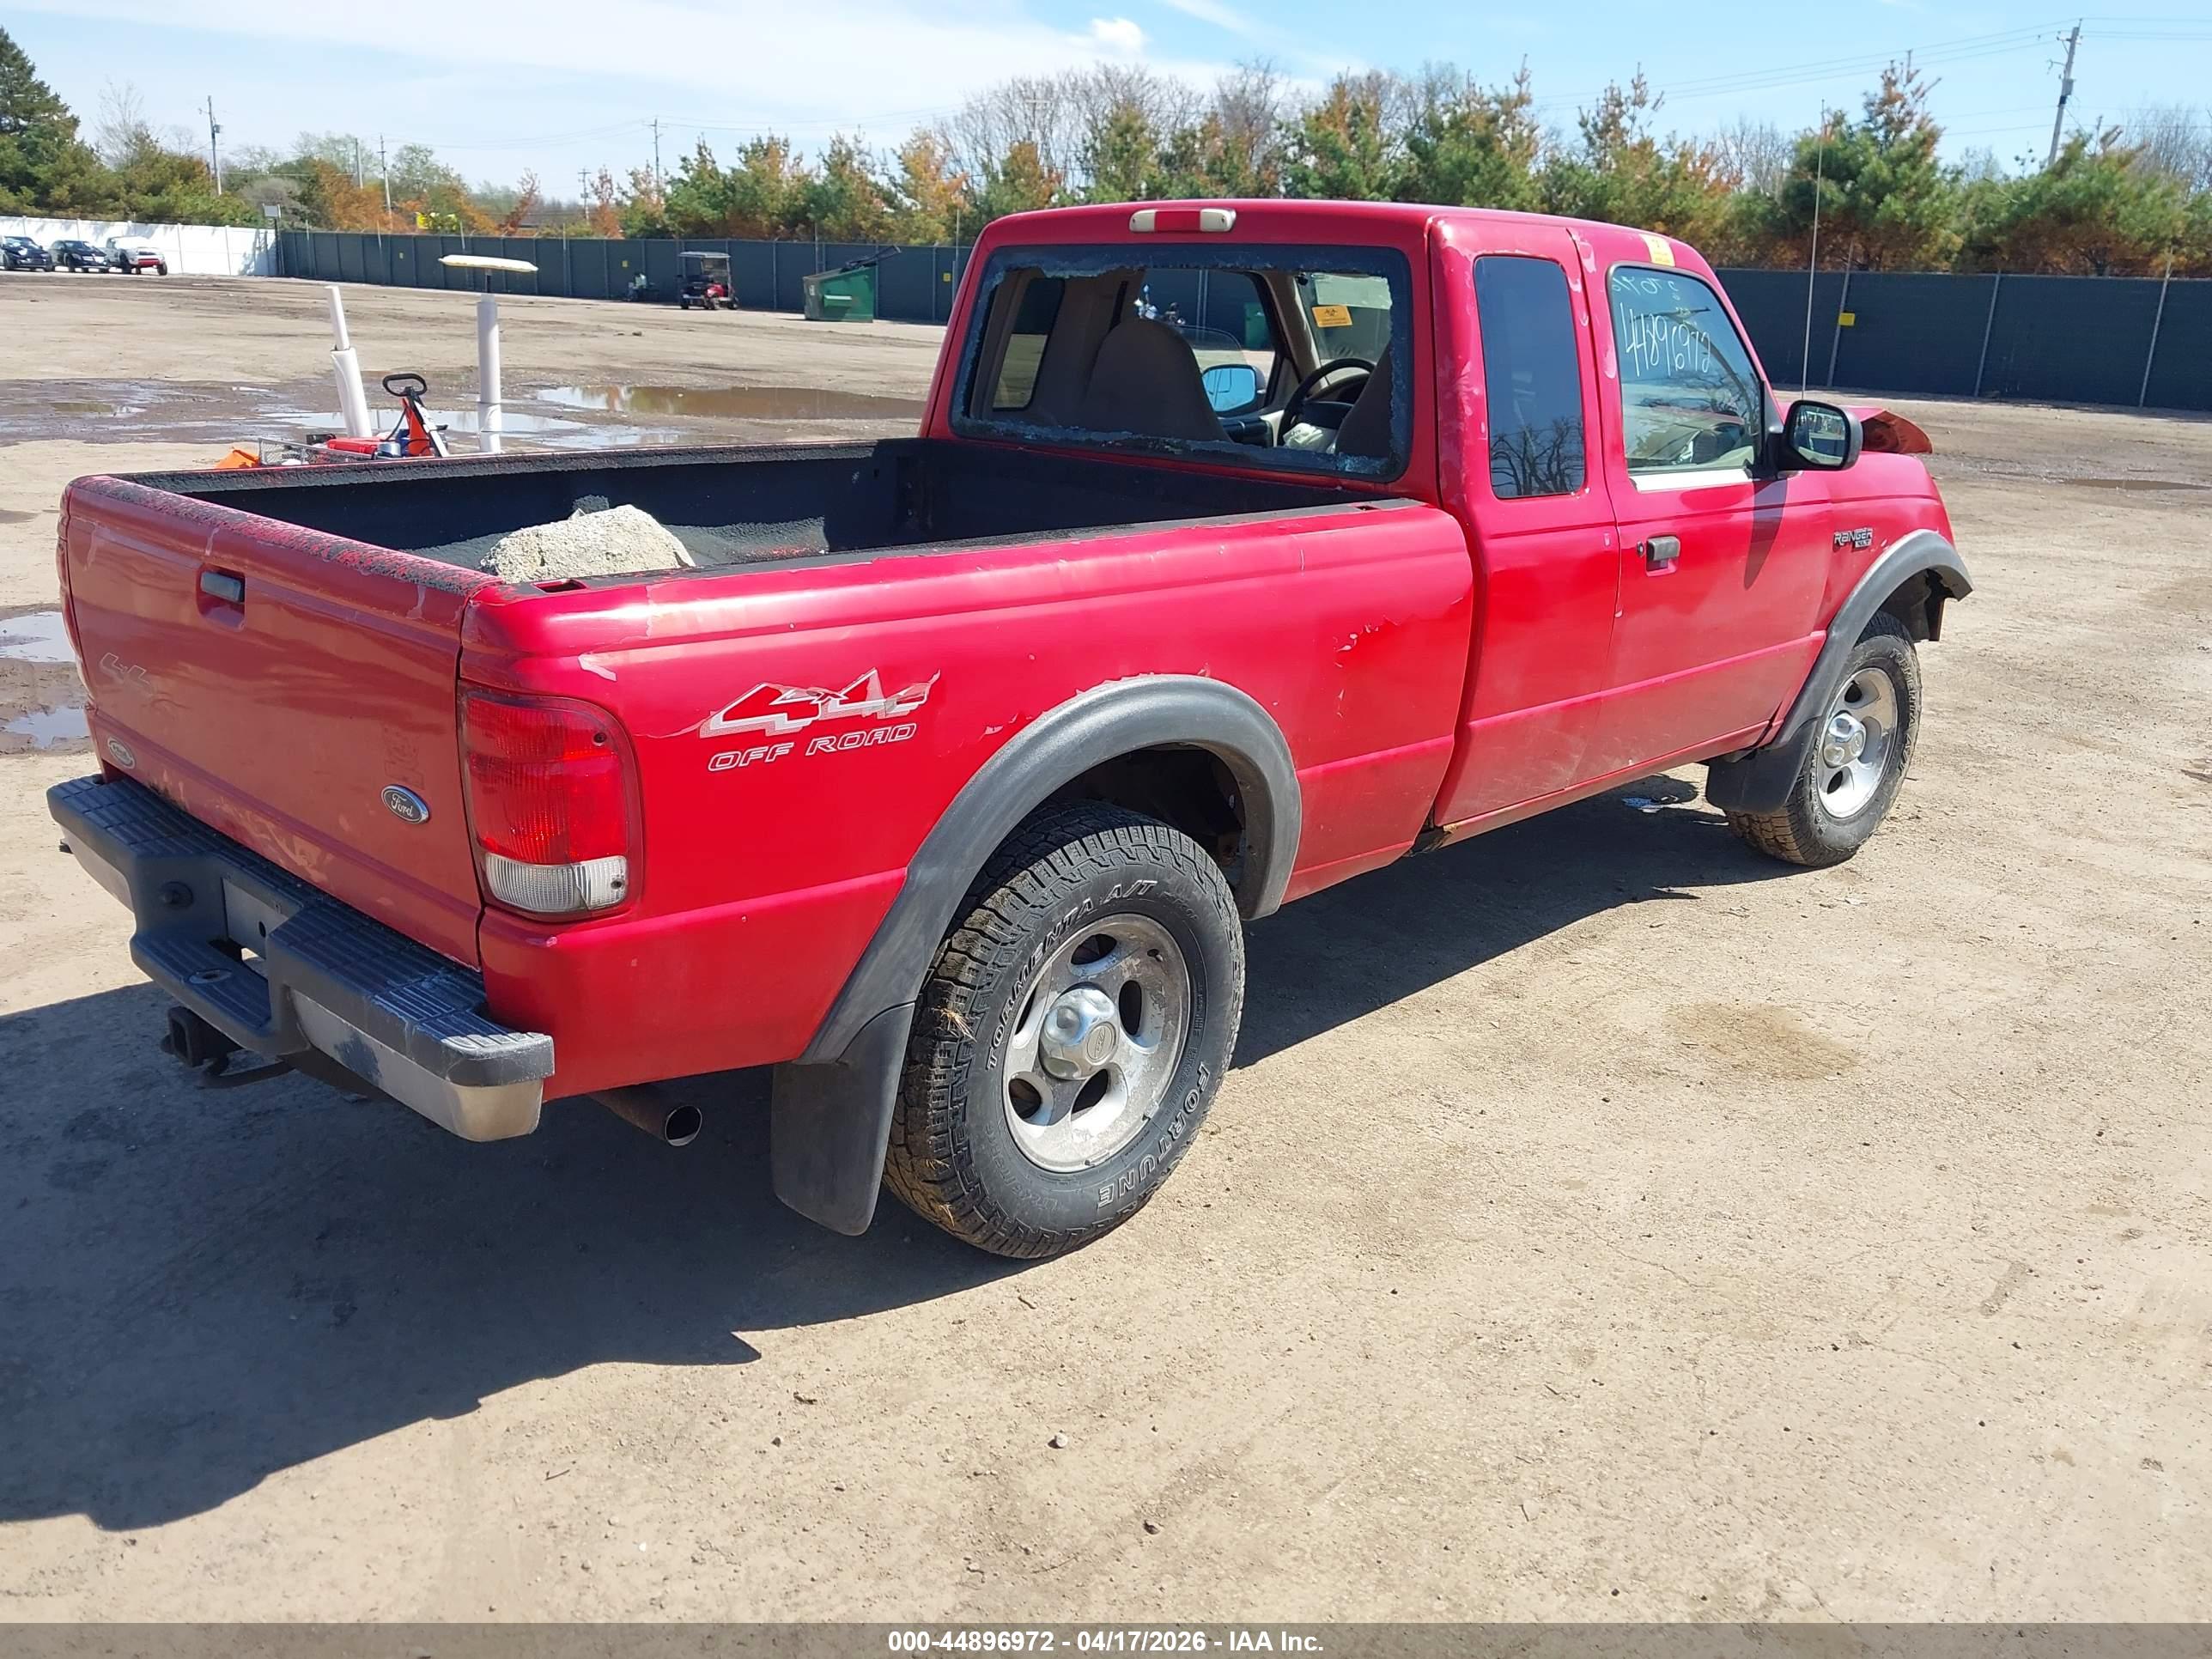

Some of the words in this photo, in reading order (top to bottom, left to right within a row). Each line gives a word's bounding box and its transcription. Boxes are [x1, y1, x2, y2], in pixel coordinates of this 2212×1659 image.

[1620, 302, 1711, 378] 44896972
[1834, 528, 1873, 546] RANGER
[708, 742, 794, 772] OFF
[805, 722, 917, 757] ROAD
[987, 898, 1093, 1071] TORMENTA
[1103, 879, 1158, 903] A/T
[1098, 1060, 1211, 1208] FORTUNE
